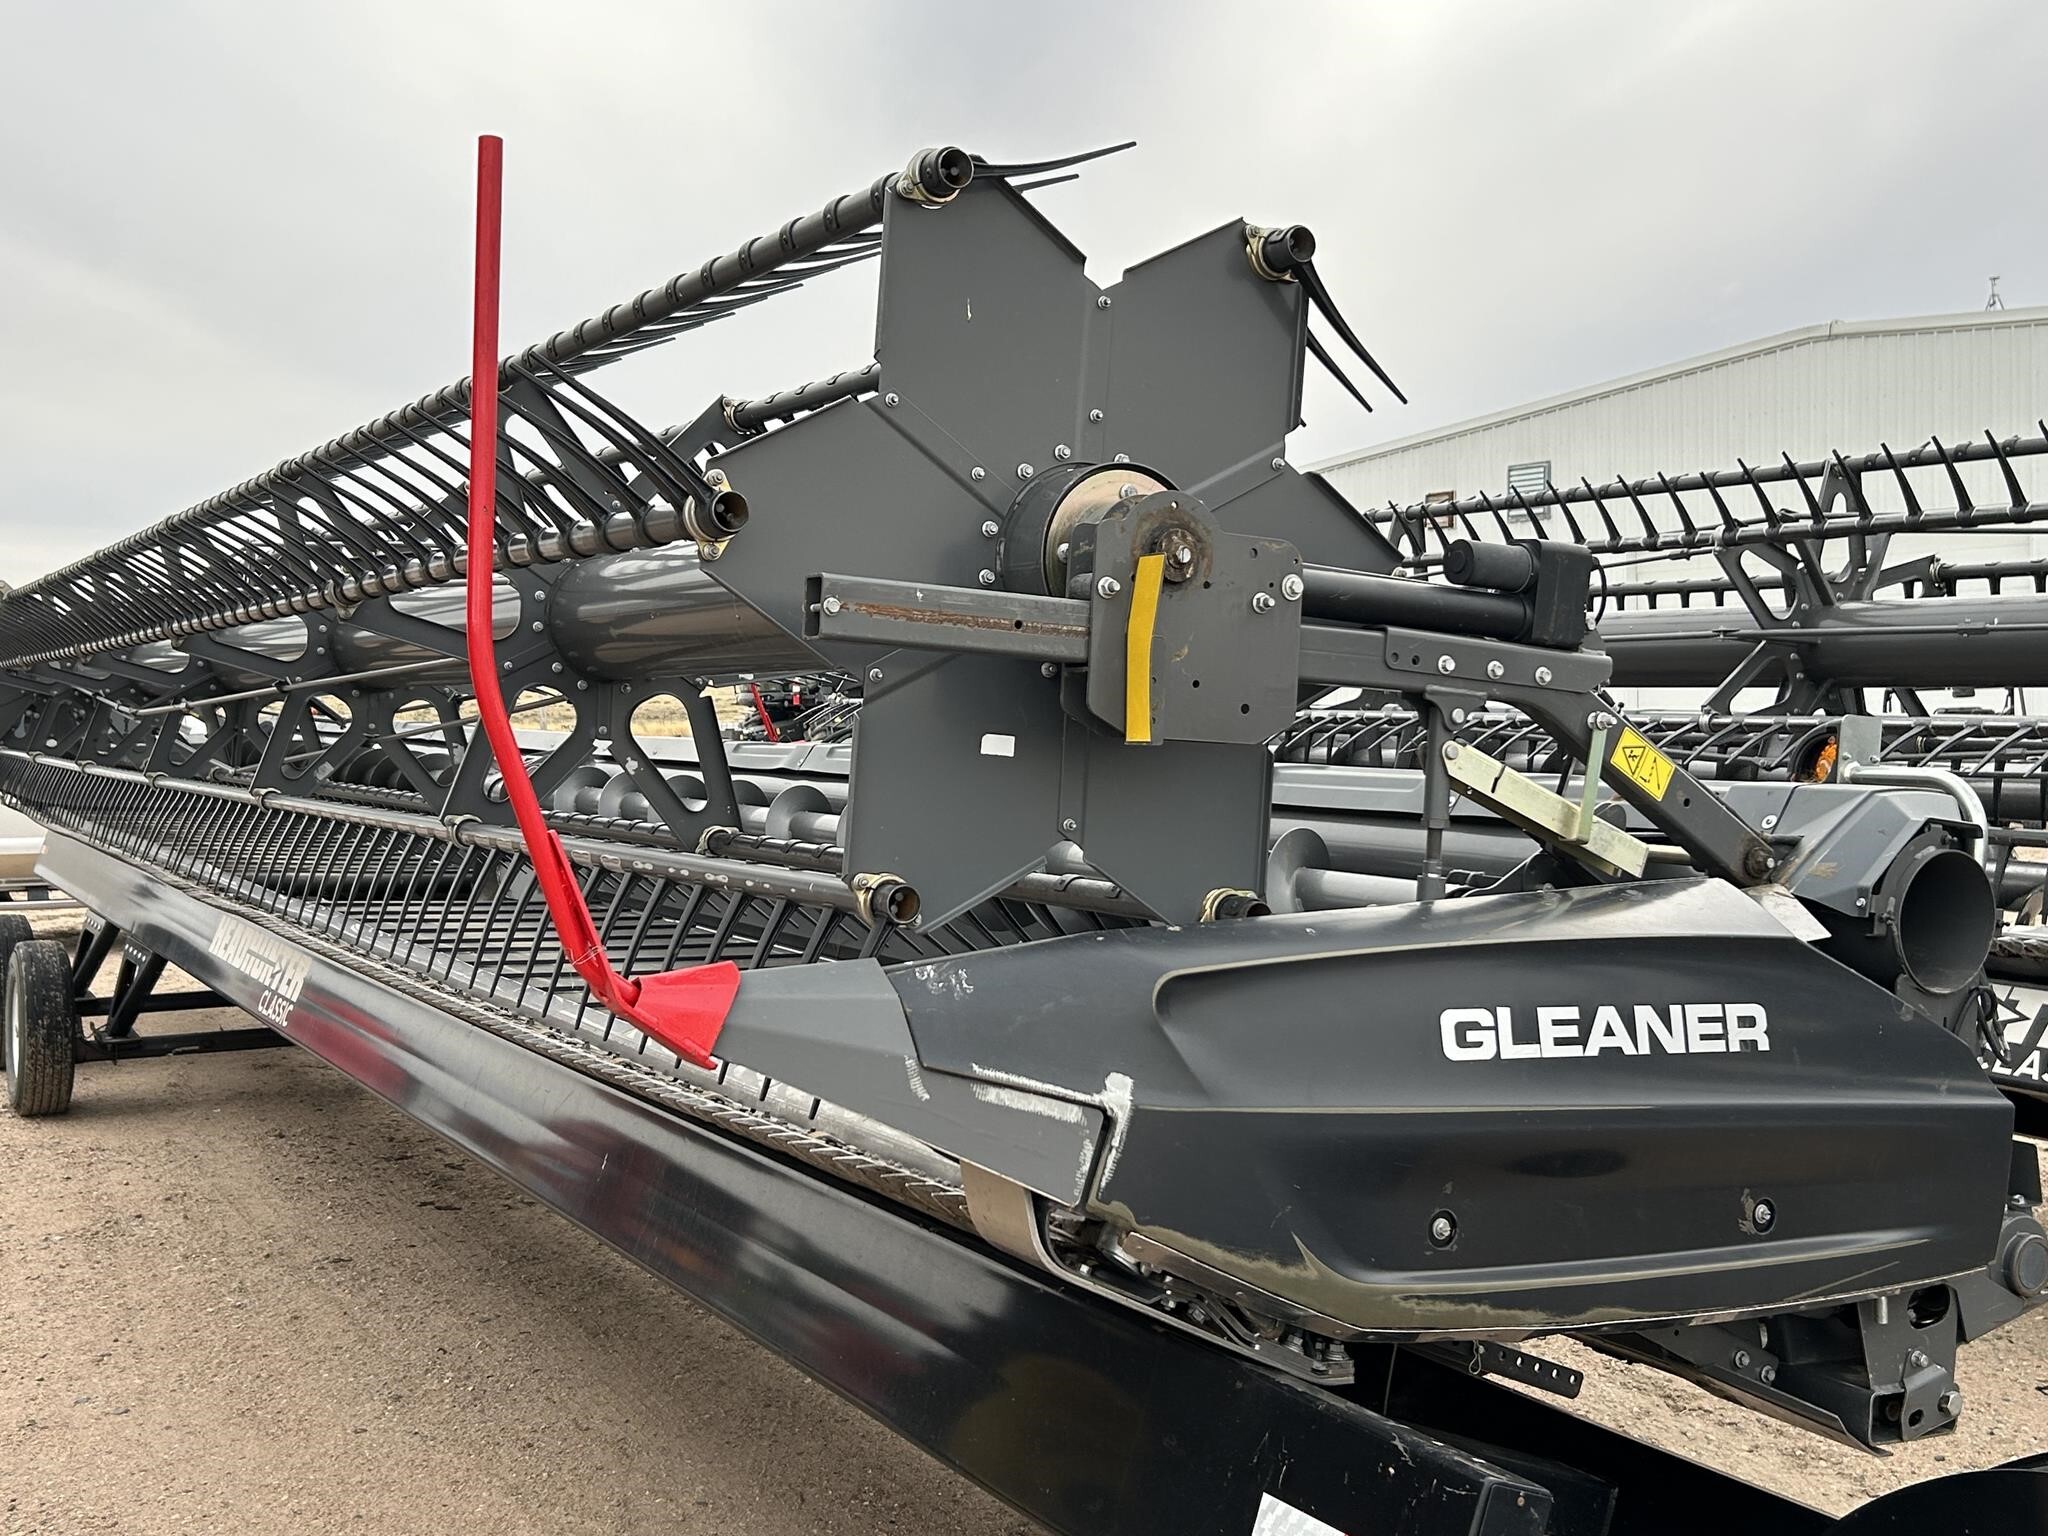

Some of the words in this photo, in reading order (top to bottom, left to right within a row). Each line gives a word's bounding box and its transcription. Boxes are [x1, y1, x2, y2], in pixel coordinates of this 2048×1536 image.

[208, 915, 312, 1003] HEADHUNTER
[258, 989, 294, 1027] CLASSIC
[1439, 1003, 1770, 1061] GLEANER
